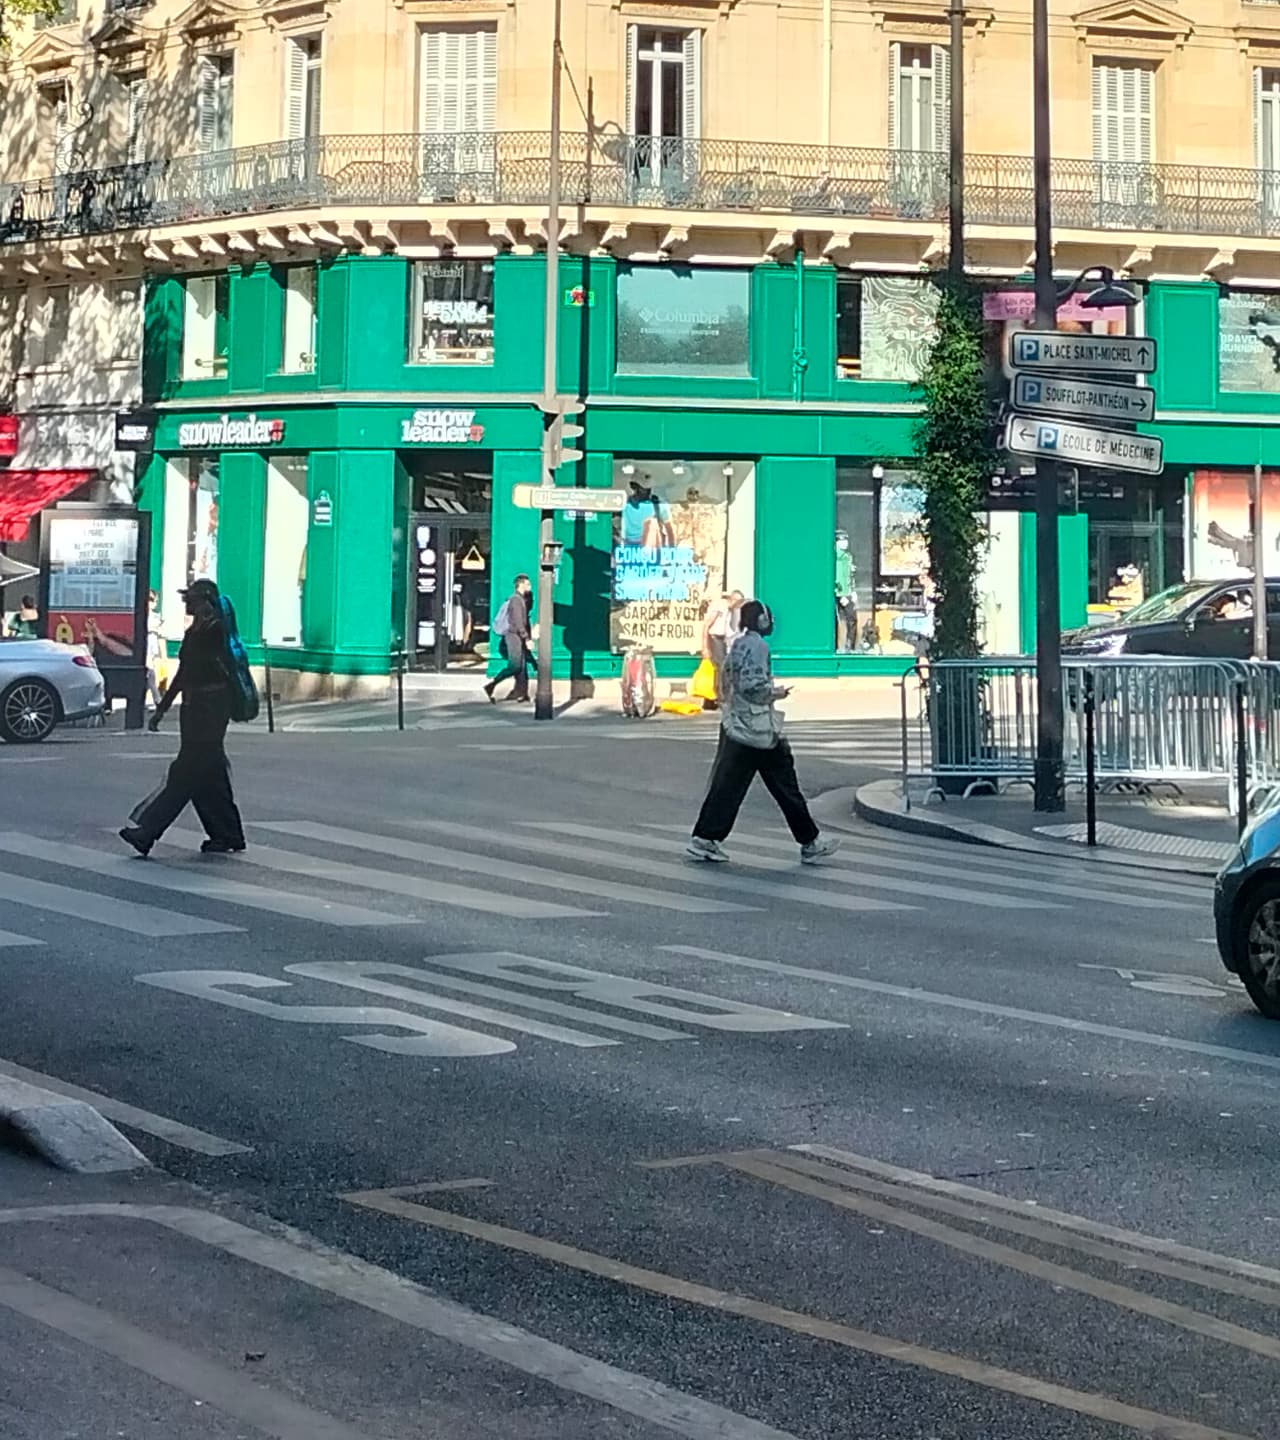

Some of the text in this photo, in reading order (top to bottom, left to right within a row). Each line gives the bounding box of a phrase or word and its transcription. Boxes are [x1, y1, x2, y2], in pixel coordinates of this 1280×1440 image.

[654, 308, 719, 324] Columbia
[1043, 344, 1071, 359] PLACE
[1074, 345, 1133, 362] SAINT-MICHEL
[1045, 387, 1129, 410] SOUFFLOT-PANTHÉON
[412, 410, 476, 427] snow
[178, 414, 272, 446] snowleader
[401, 421, 471, 443] leader
[1062, 432, 1092, 452] ÉCOLE
[1095, 440, 1107, 454] DE
[1109, 439, 1155, 462] MÉDECINE
[615, 547, 657, 564] CONÇU
[623, 606, 705, 621] GARDER VOTR
